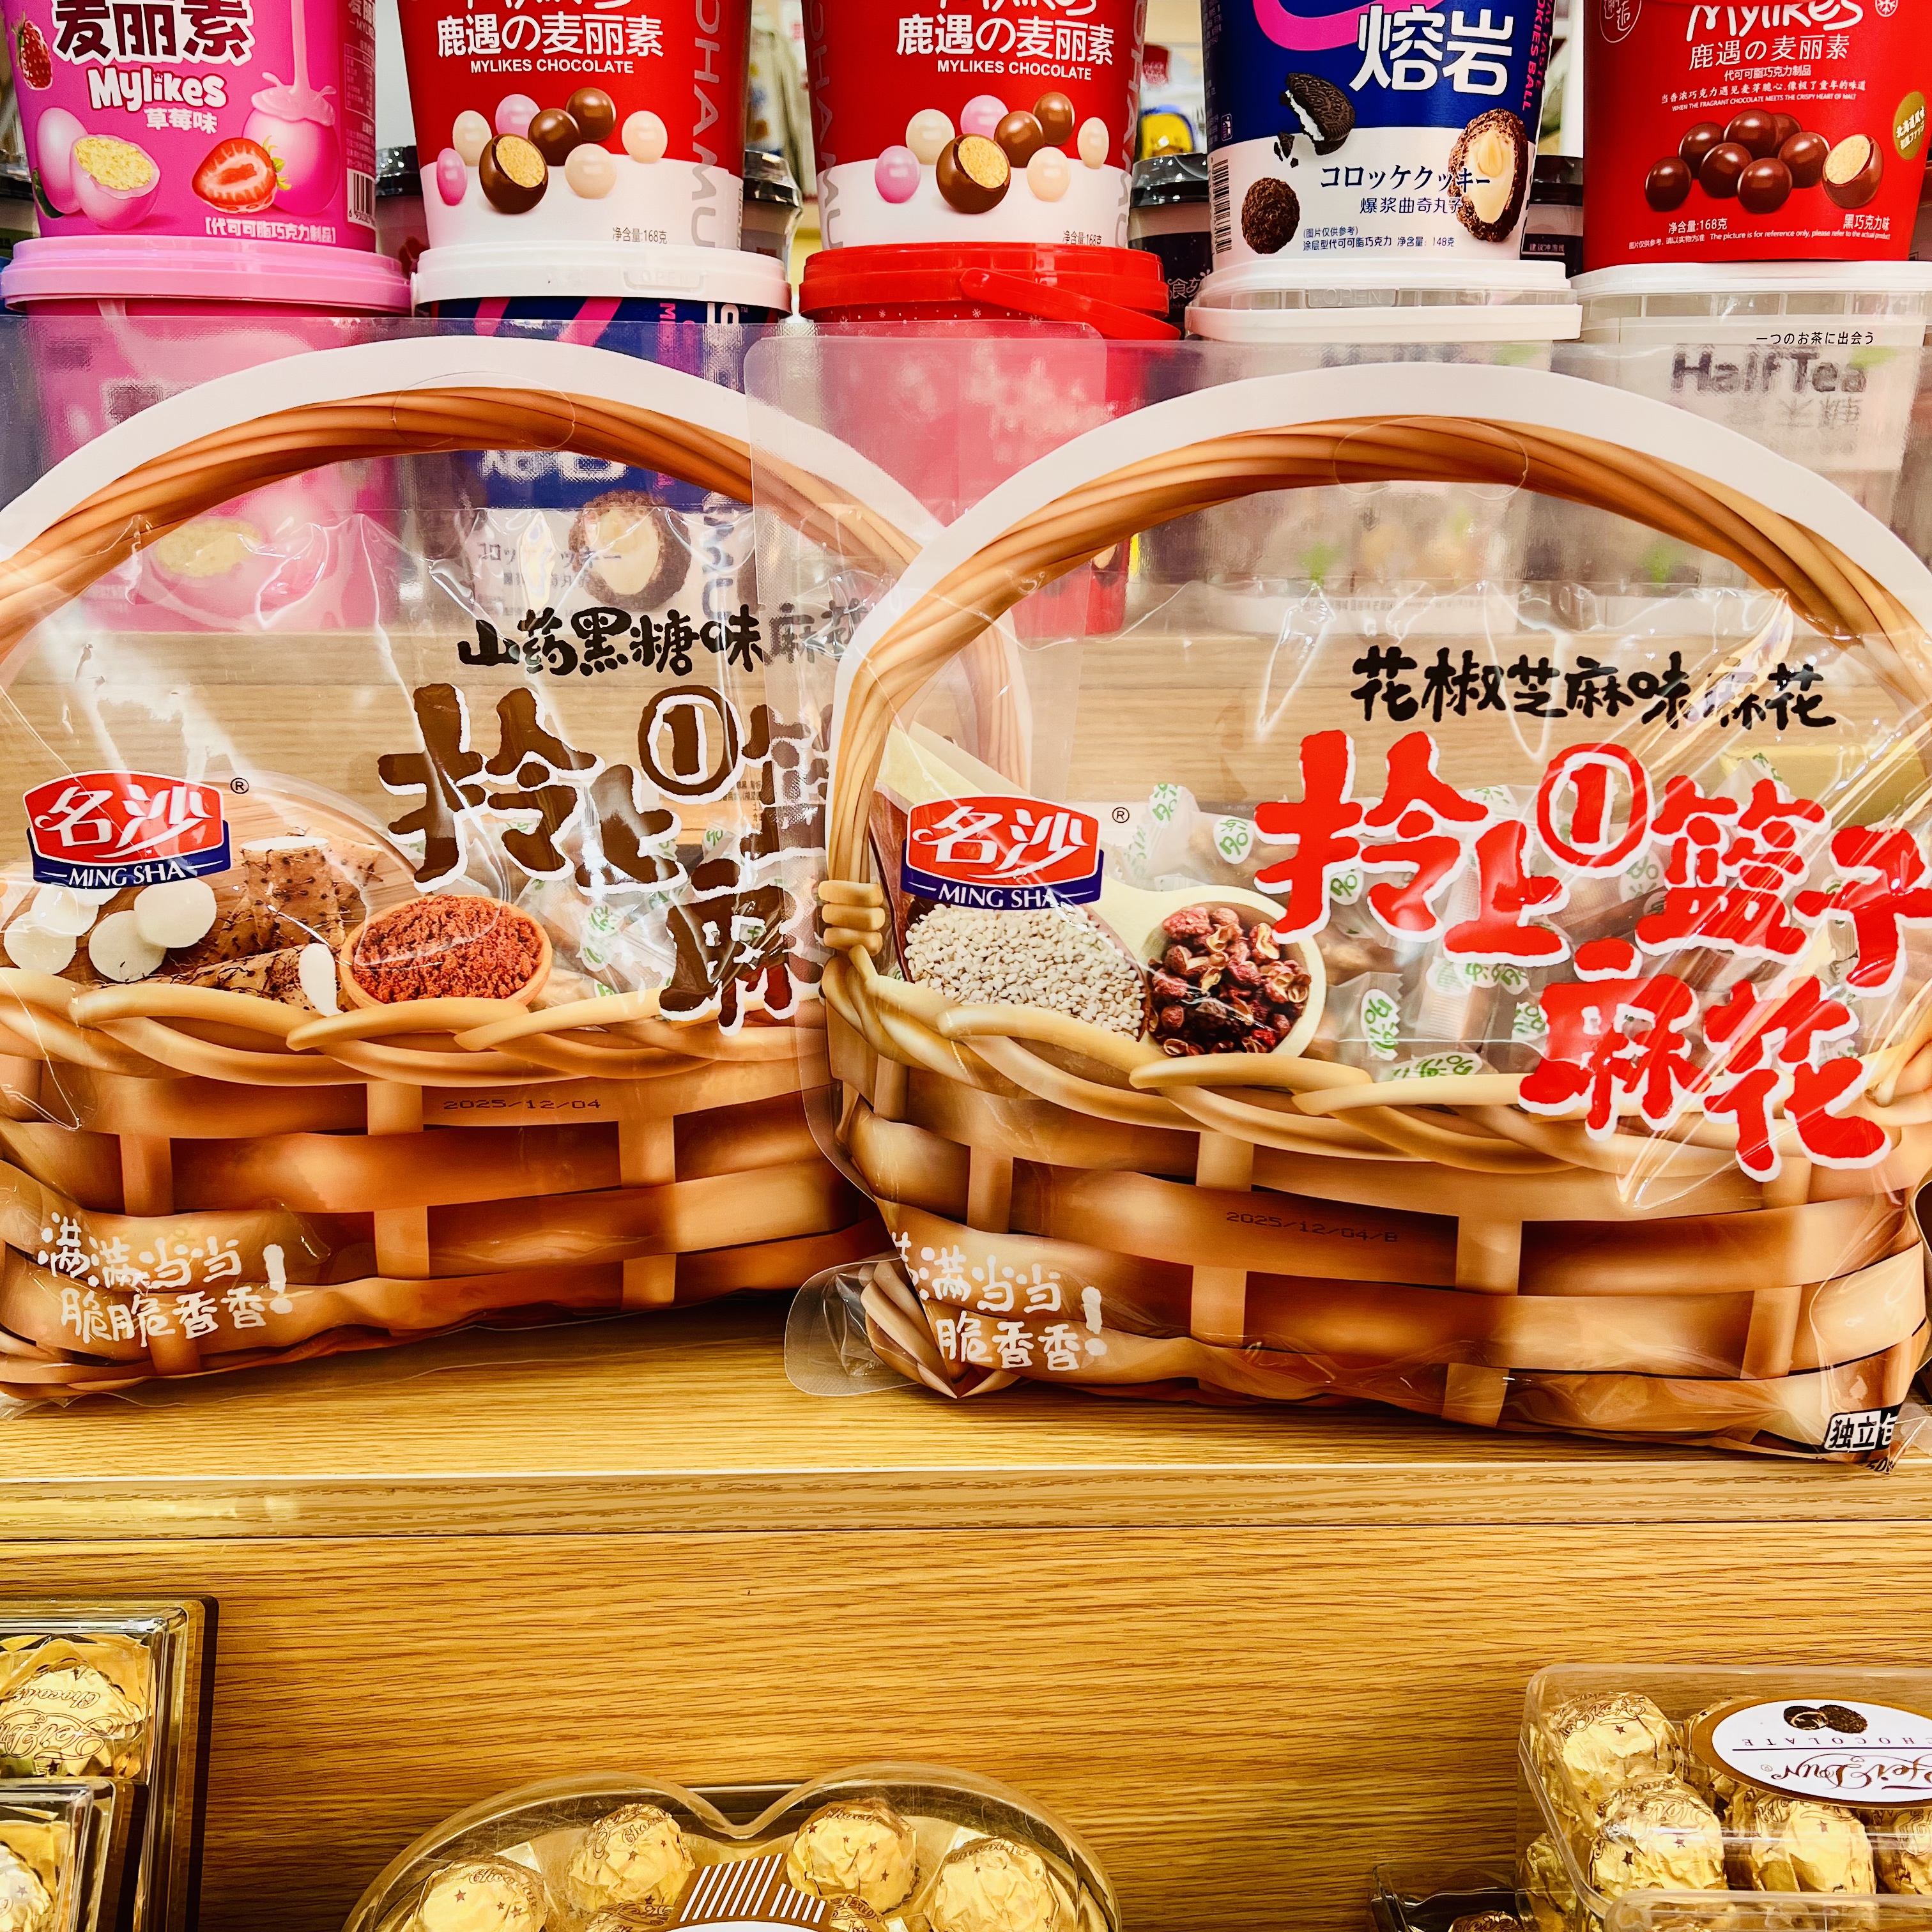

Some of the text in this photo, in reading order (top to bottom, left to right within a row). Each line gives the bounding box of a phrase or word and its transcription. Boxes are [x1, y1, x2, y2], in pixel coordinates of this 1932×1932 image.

[55, 0, 250, 59] 麦丽素
[438, 11, 663, 57] 鹿遇の麦丽素
[896, 13, 1114, 65] 鹿遇の麦丽素
[1349, 5, 1514, 96] 熔岩
[1689, 34, 1850, 70] 鹿遇の麦丽素
[471, 59, 634, 73] MYLIKES CHOCOLATE
[937, 59, 1092, 80] MYLIKES CHOCOLATE
[1724, 65, 1811, 81] 代可可脂巧克力制品
[87, 66, 227, 111] Mylikes
[1522, 61, 1537, 111] BALL
[1700, 99, 1729, 107] FRAGRANT
[1730, 96, 1763, 105] CHOCOLATE
[144, 107, 218, 134] 草莓味
[1321, 164, 1491, 191] コロッケクッキー
[1360, 197, 1462, 214] 爆浆曲奇丸子
[613, 227, 667, 244] 净含量:168克
[1668, 218, 1728, 234] 净含量:168克
[1723, 232, 1745, 241] picture
[1811, 230, 1830, 238] please
[1843, 214, 1890, 231] 黑巧克力味
[1323, 287, 1383, 305] OPEN
[1756, 332, 1874, 346] 一つのお茶に出会う
[1351, 645, 1837, 730] 花椒芝麻味麻花
[35, 784, 213, 858] 名沙
[912, 805, 1089, 880] 名沙
[69, 861, 187, 887] MING SHA
[937, 883, 1059, 909] MING SHA
[1519, 937, 1892, 1174] 麻花
[443, 1099, 601, 1109] 2025/12/04
[37, 1212, 241, 1289] 满满当当
[892, 1231, 1061, 1313] 满当当
